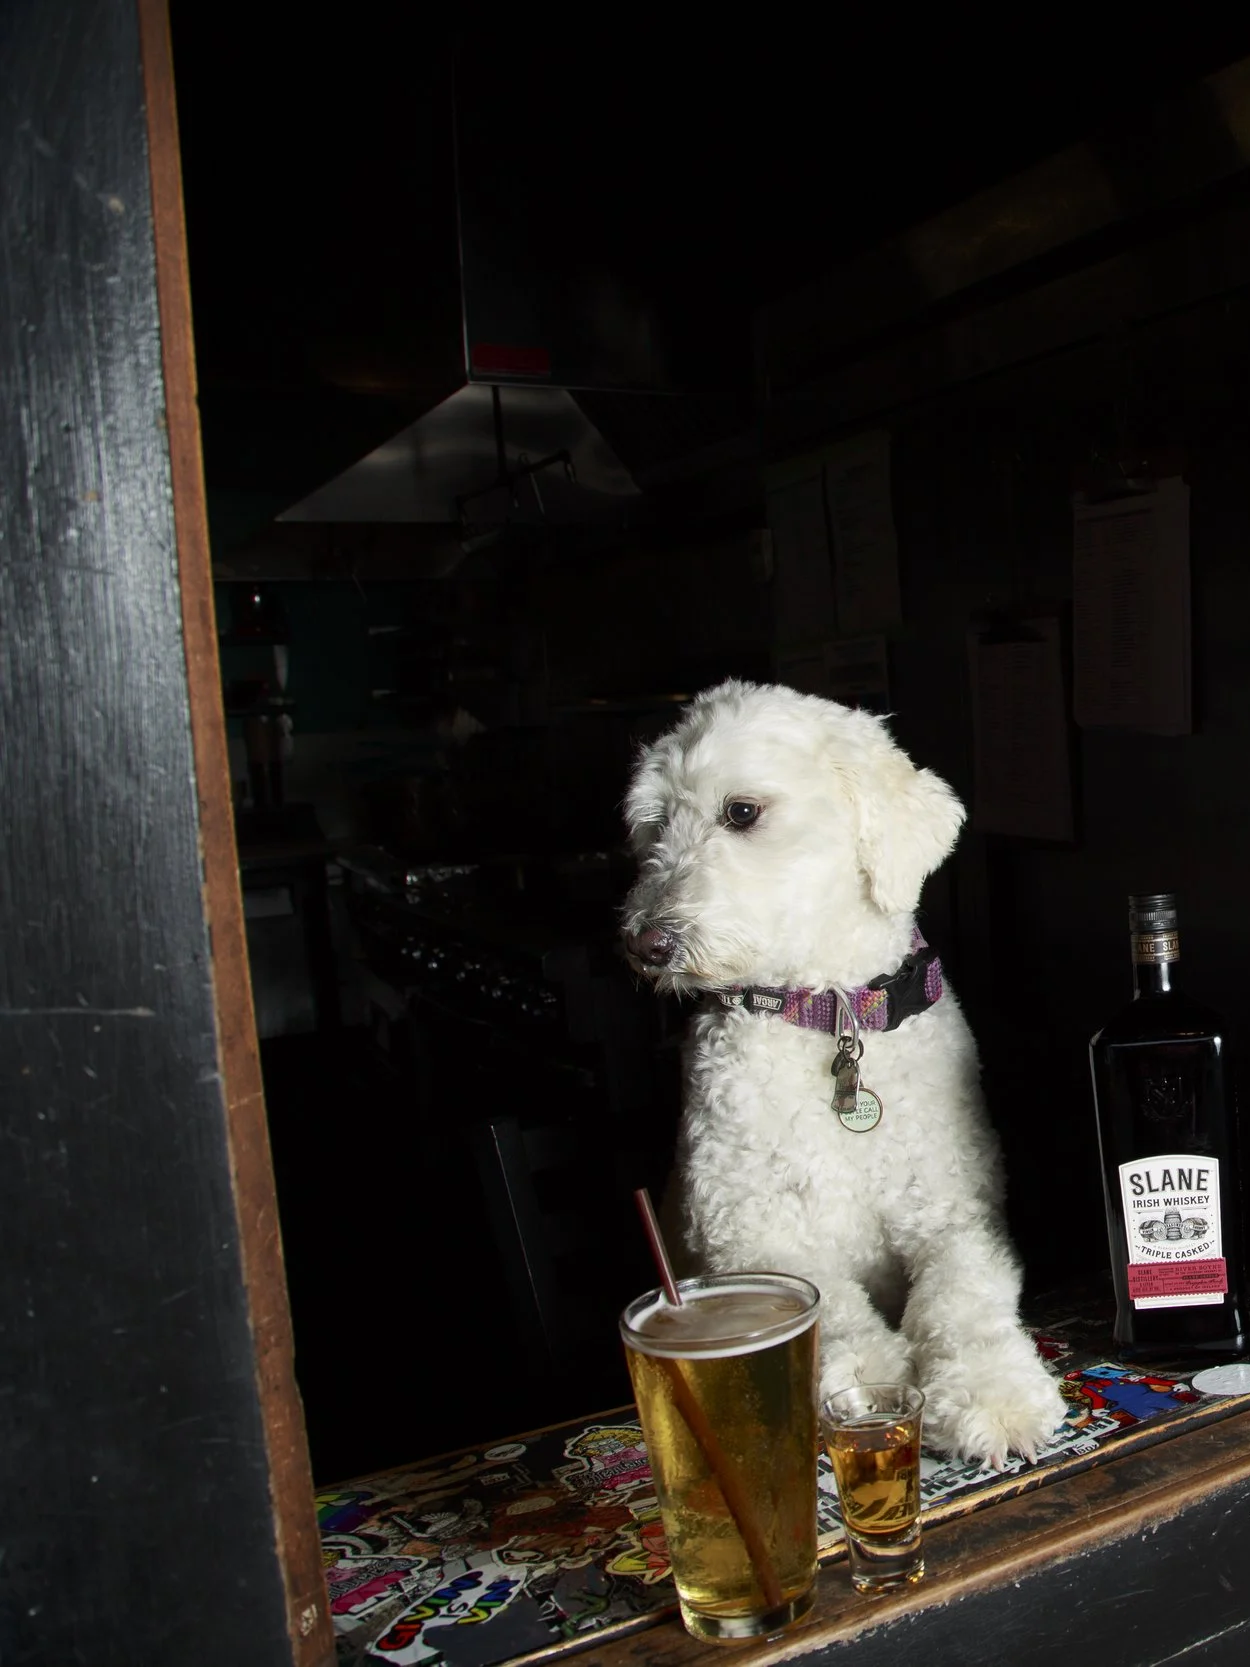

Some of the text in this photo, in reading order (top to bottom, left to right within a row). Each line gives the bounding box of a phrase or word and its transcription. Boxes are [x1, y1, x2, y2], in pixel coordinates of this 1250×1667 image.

[855, 1113, 878, 1121] PEOPLE
[1129, 1168, 1210, 1196] SLANE
[1132, 1195, 1210, 1208] IRISH WHISKEY
[1141, 1245, 1172, 1259] TRIPLE
[1175, 1242, 1211, 1259] CASKED
